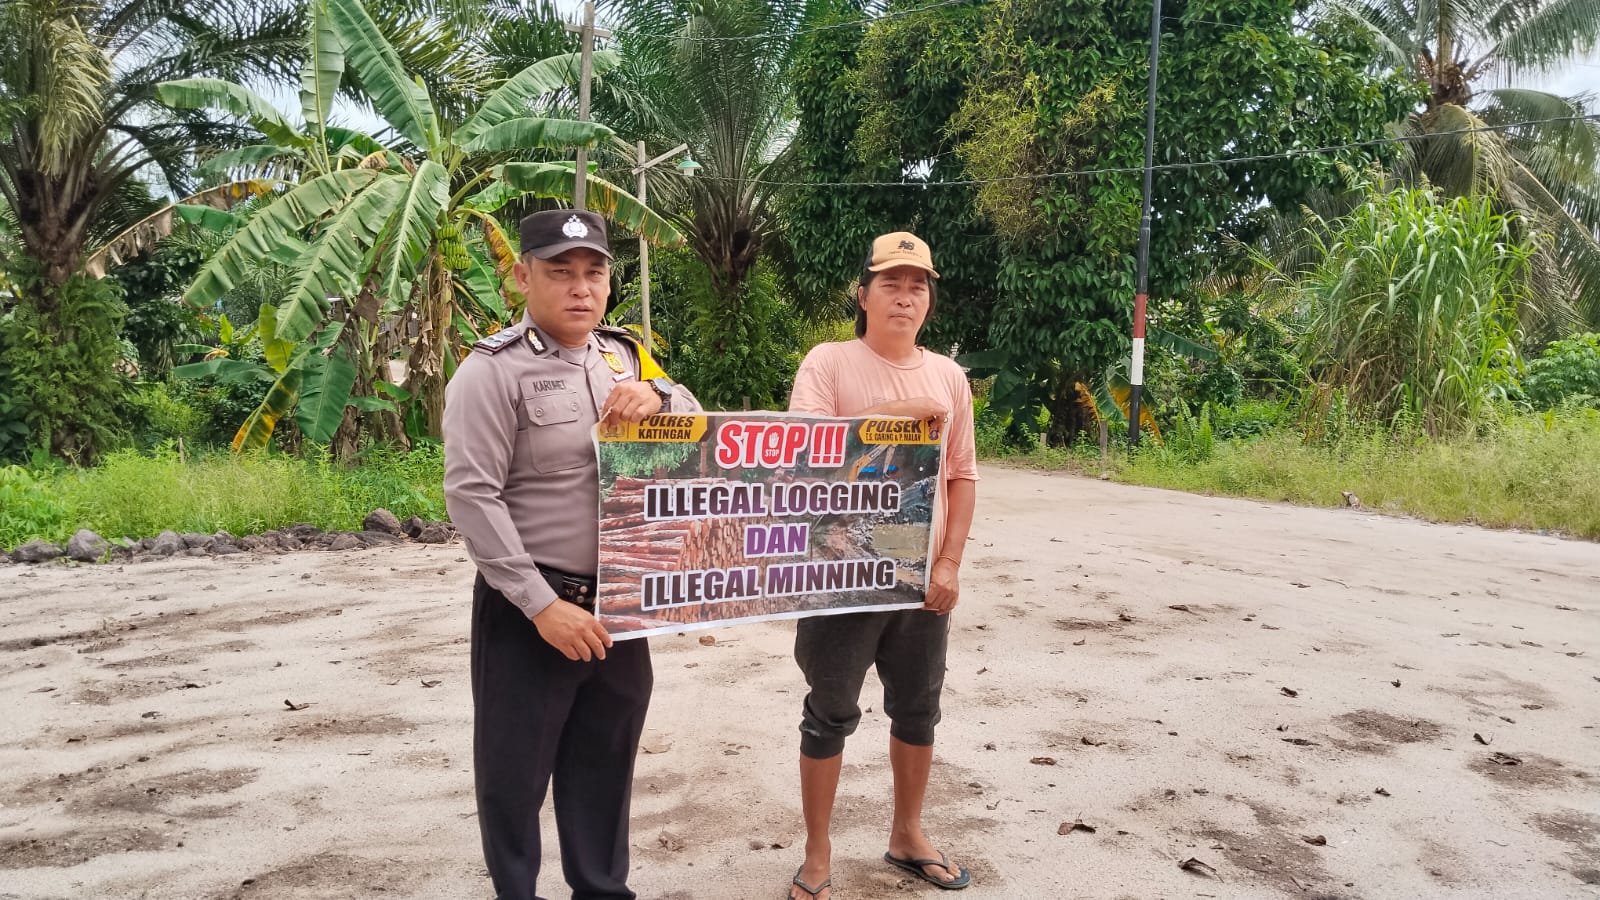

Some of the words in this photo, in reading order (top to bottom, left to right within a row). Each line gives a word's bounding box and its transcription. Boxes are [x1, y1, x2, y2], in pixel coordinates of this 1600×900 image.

[639, 414, 696, 428] POLRES
[866, 419, 922, 433] POLSEK
[638, 428, 691, 440] KATINGAN
[717, 422, 807, 466] STOP
[764, 448, 780, 458] STOP
[646, 485, 767, 518] ILLEGAL
[773, 482, 900, 514] LOGGING
[746, 524, 808, 555] DAN
[643, 567, 761, 608] ILLEGAL
[767, 560, 896, 595] MINNING
